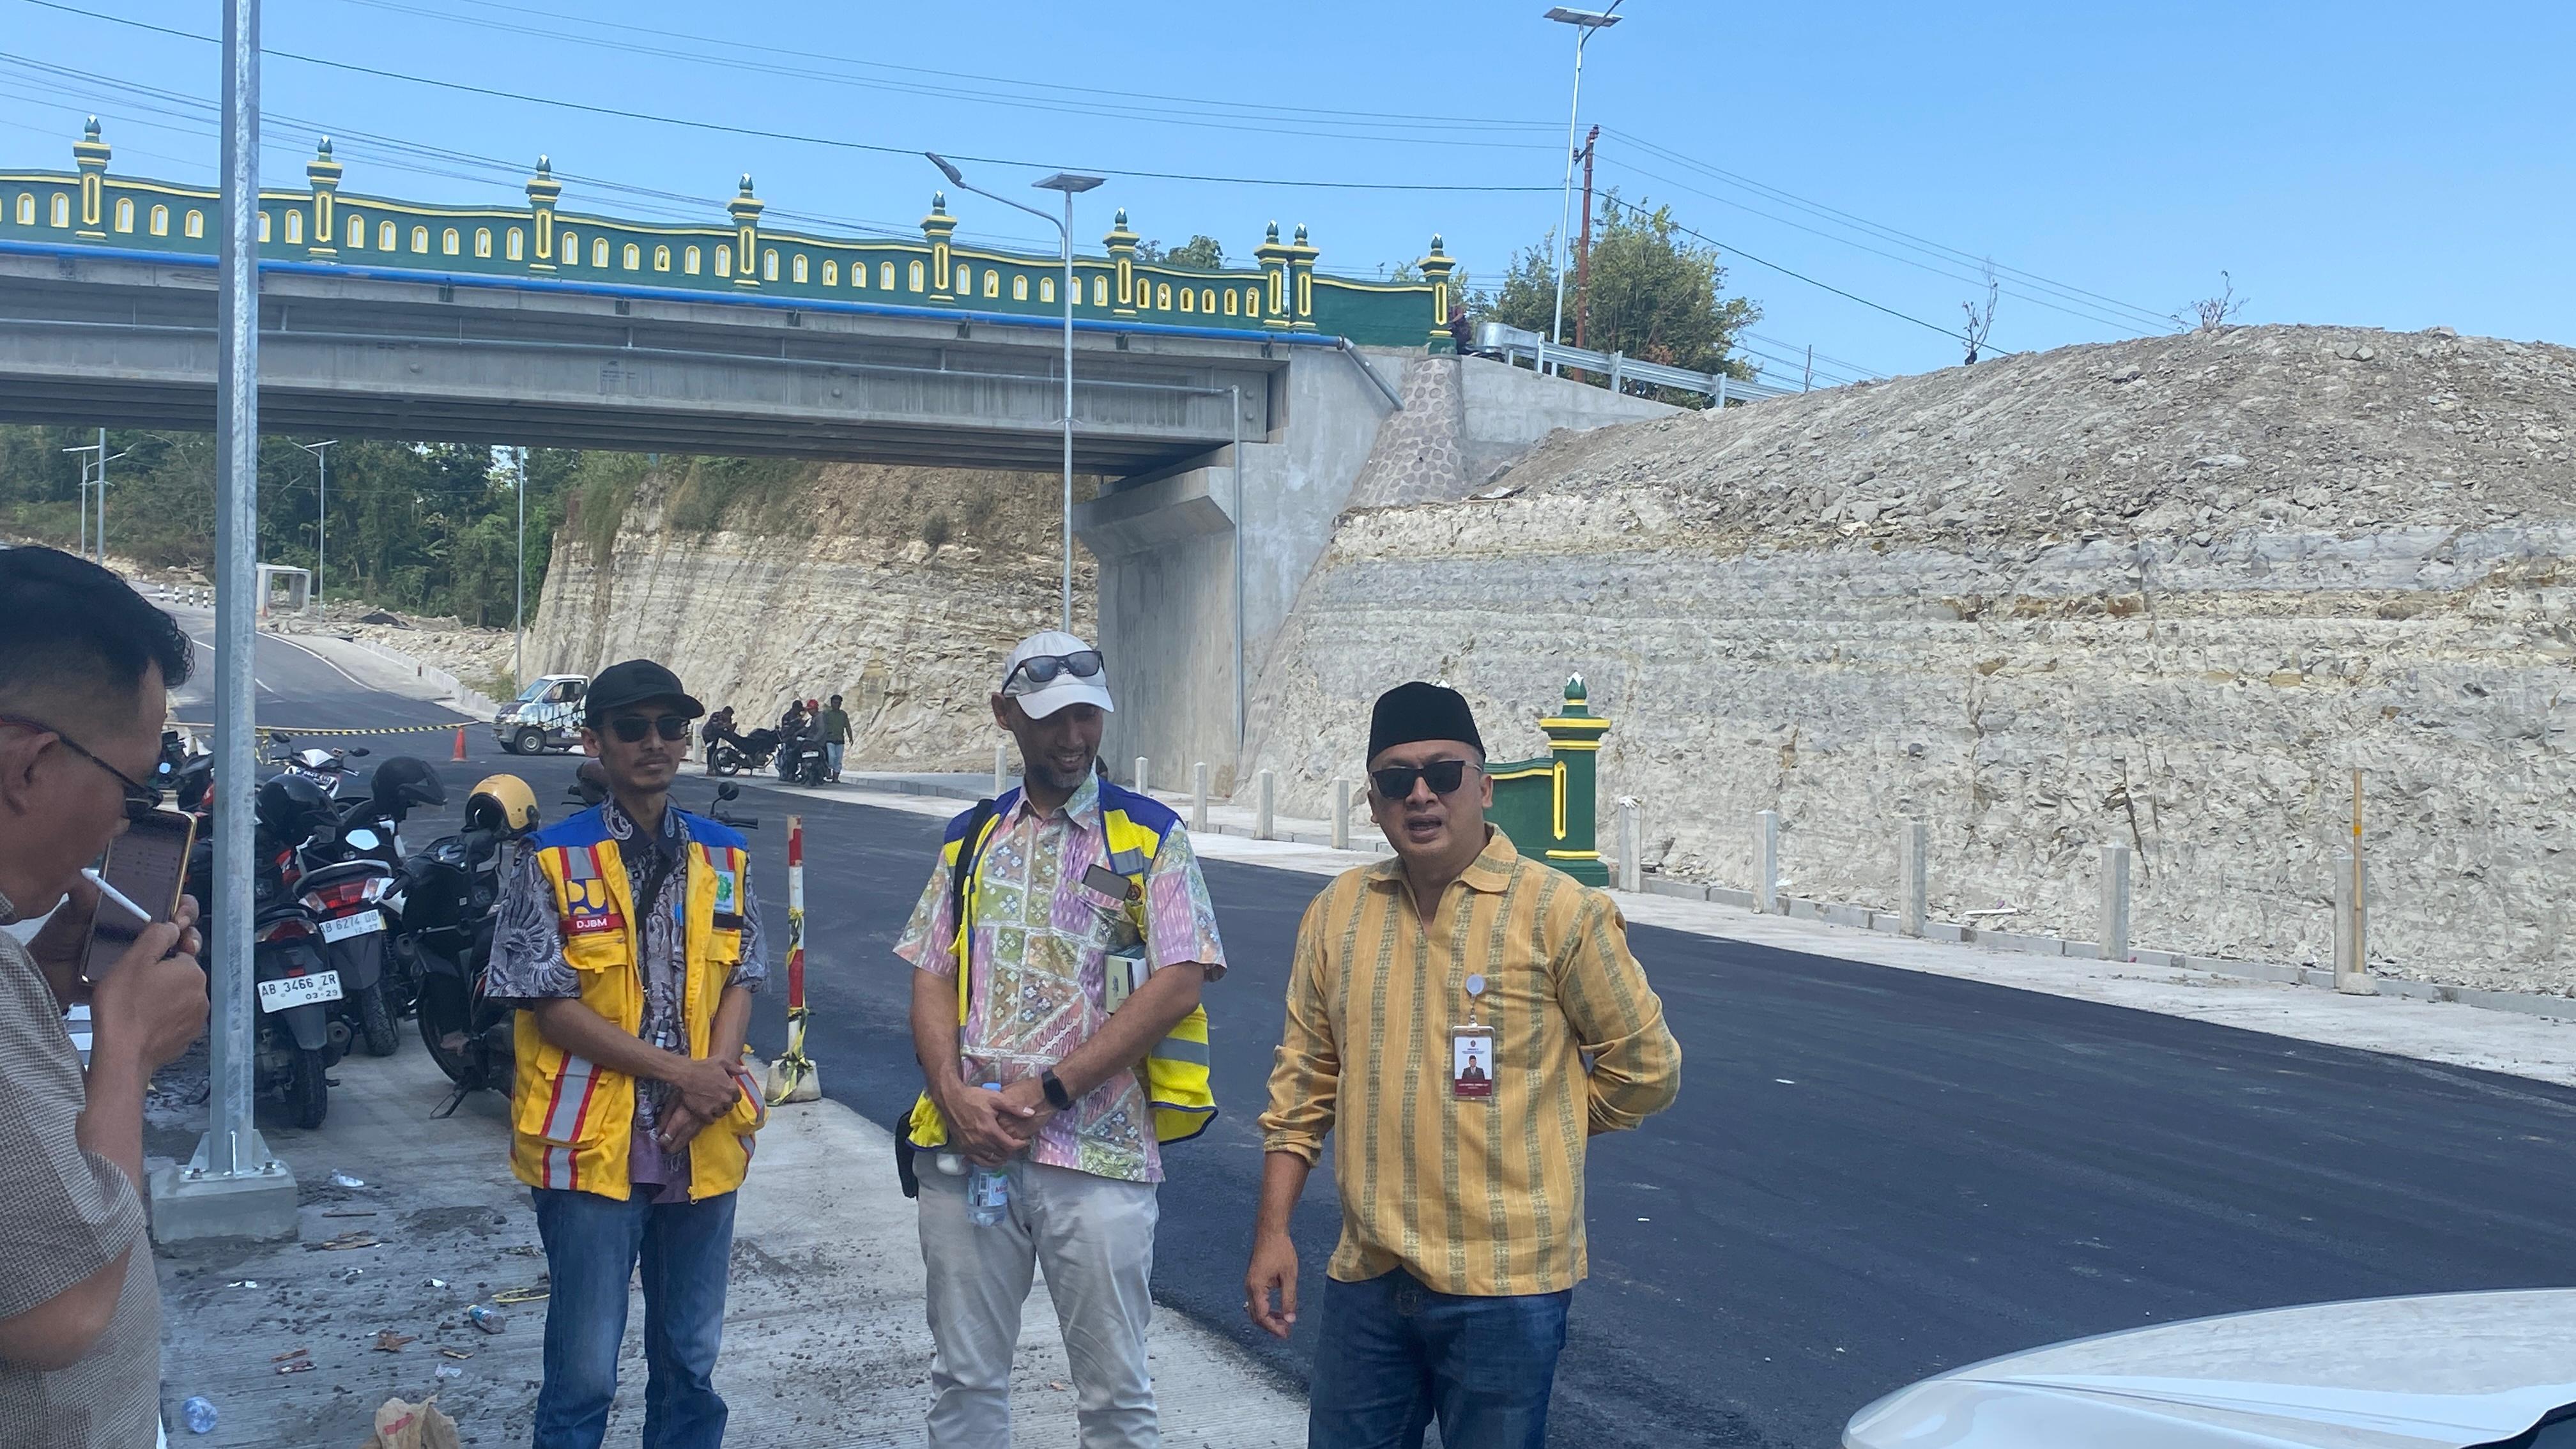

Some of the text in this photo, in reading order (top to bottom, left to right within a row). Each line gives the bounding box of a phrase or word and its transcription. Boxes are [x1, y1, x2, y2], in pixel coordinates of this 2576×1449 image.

[576, 918, 608, 929] DJBM
[262, 974, 337, 997] AB 3466 ZR
